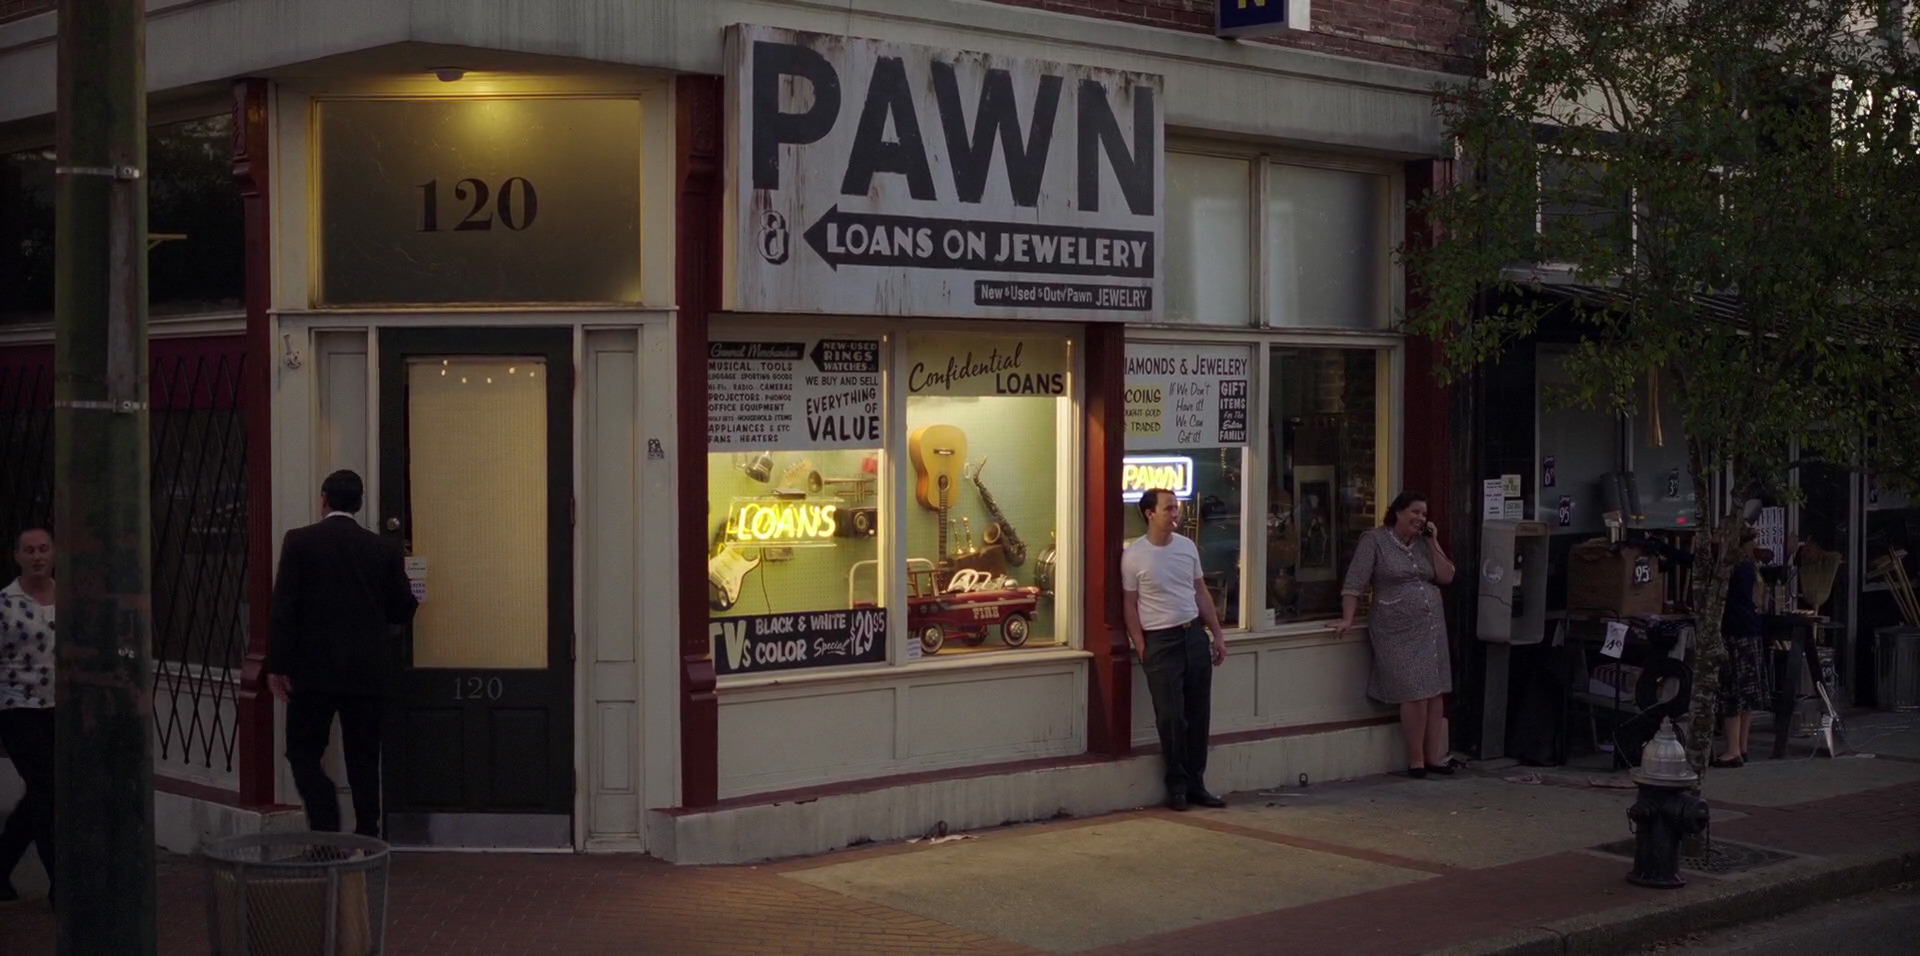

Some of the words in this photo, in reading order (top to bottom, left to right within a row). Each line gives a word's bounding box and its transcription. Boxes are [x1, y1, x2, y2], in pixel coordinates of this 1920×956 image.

[752, 41, 1155, 217] PAWN
[416, 177, 537, 232] 120
[758, 210, 788, 264] &
[826, 222, 934, 259] LOANS
[943, 229, 986, 261] ON
[993, 232, 1148, 269] JEWELERY
[981, 284, 1003, 300] New
[1011, 285, 1036, 301] Used
[1067, 287, 1093, 304] Pawn
[1096, 288, 1148, 308] JEWELRY
[823, 350, 873, 362] RINGS
[760, 361, 793, 371] TOOLS
[824, 361, 868, 371] WATCHES
[909, 342, 1023, 393] Confidential
[1124, 357, 1176, 375] IAMONDS
[1180, 359, 1188, 375] &
[805, 376, 819, 386] WE
[821, 376, 837, 386] BUY
[840, 376, 857, 386] AND
[860, 376, 878, 386] SELL
[996, 372, 1064, 394] LOANS
[1220, 381, 1246, 397] GIFT
[708, 393, 760, 401] PROJECTORS
[806, 387, 876, 416] EVERYTHING
[1124, 388, 1162, 404] COINS
[1220, 397, 1246, 410] ITEMS
[708, 403, 737, 412] OFFICE
[740, 403, 785, 412] EQUIPMENT
[865, 402, 878, 414] OF
[708, 424, 765, 433] APPLIANCES
[807, 415, 880, 442] VALUE
[1131, 422, 1161, 433] TRADED
[1219, 430, 1246, 441] FAMILY
[740, 434, 779, 443] HEATERS
[1123, 464, 1184, 491] PAWN
[737, 504, 837, 540] LOANS
[972, 606, 1000, 620] FIRE
[755, 616, 794, 635] BLACK
[798, 616, 807, 632] &
[810, 613, 847, 631] WHITE
[755, 639, 808, 665] COLOR
[813, 637, 850, 658] Special
[452, 676, 504, 701] 120
